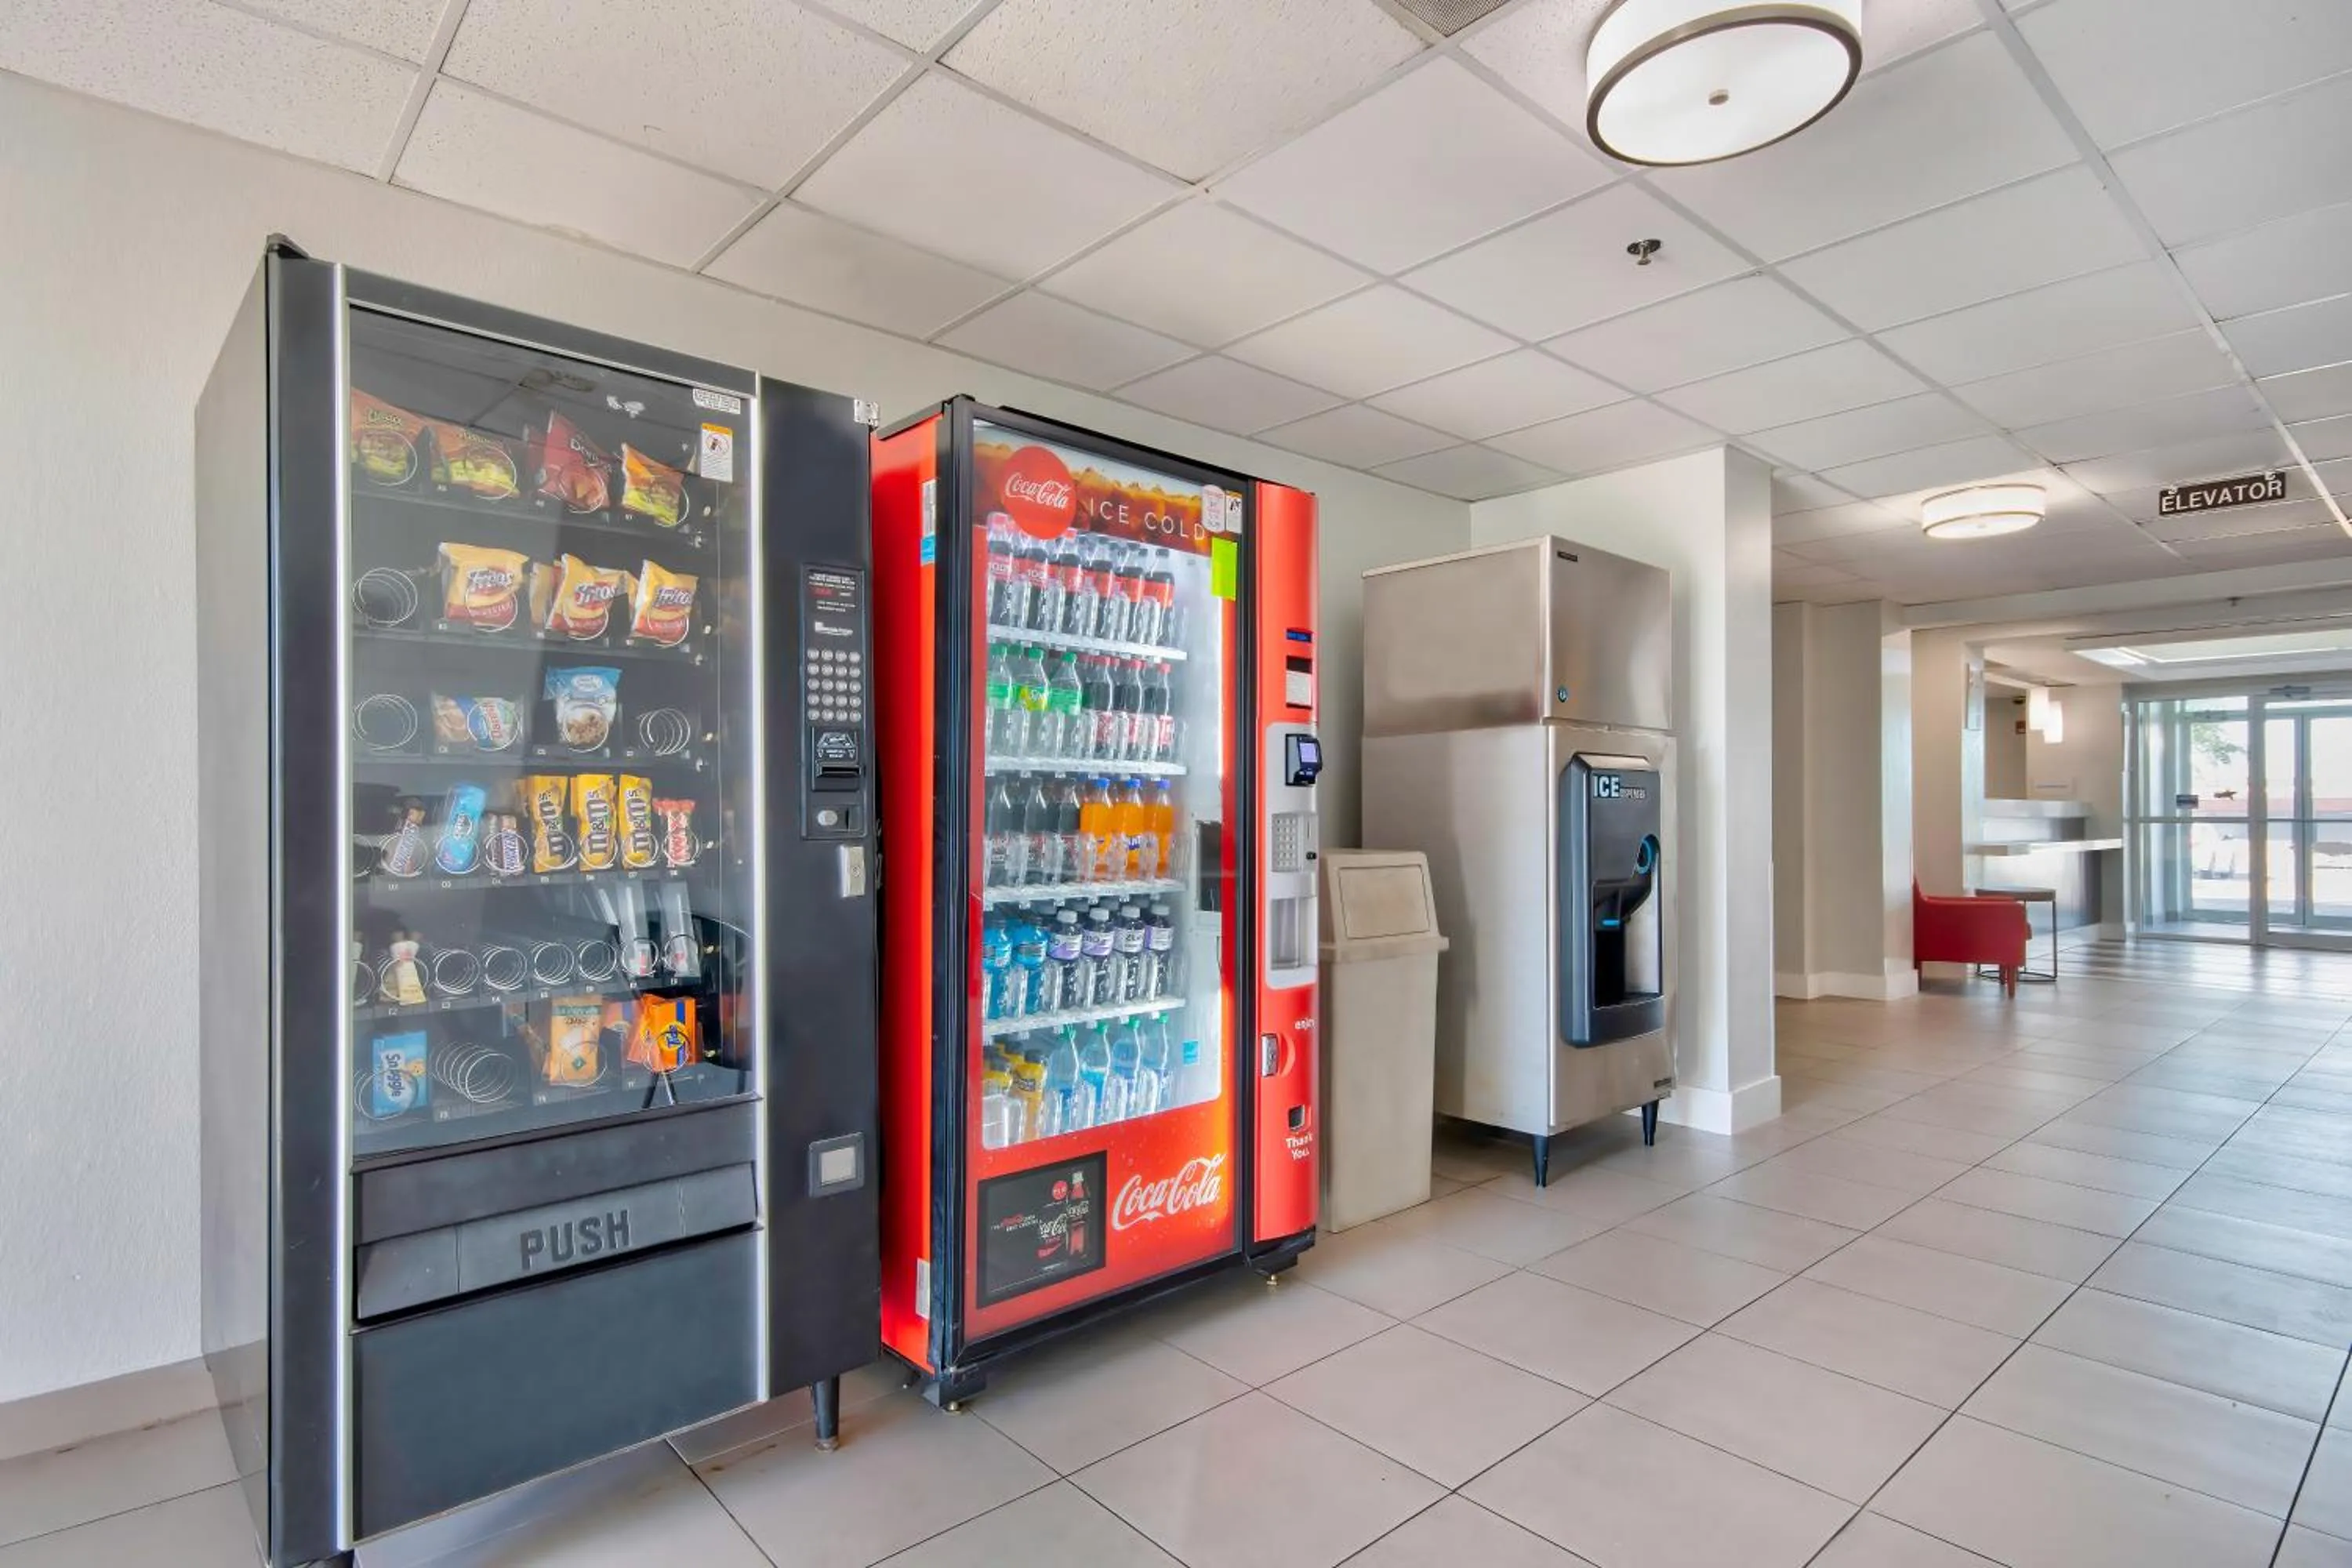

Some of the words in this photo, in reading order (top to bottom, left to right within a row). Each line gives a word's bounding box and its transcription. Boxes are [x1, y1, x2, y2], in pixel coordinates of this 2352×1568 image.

[1004, 472, 1072, 509] Coca-Cola
[2161, 479, 2282, 512] ELEVATOR
[1089, 498, 1130, 524] ICE
[1144, 511, 1206, 541] COLD
[1593, 775, 1620, 797] ICE
[386, 1053, 406, 1097] Snuggle
[1112, 1153, 1228, 1230] Coca-Cola
[520, 1210, 632, 1271] PUSH
